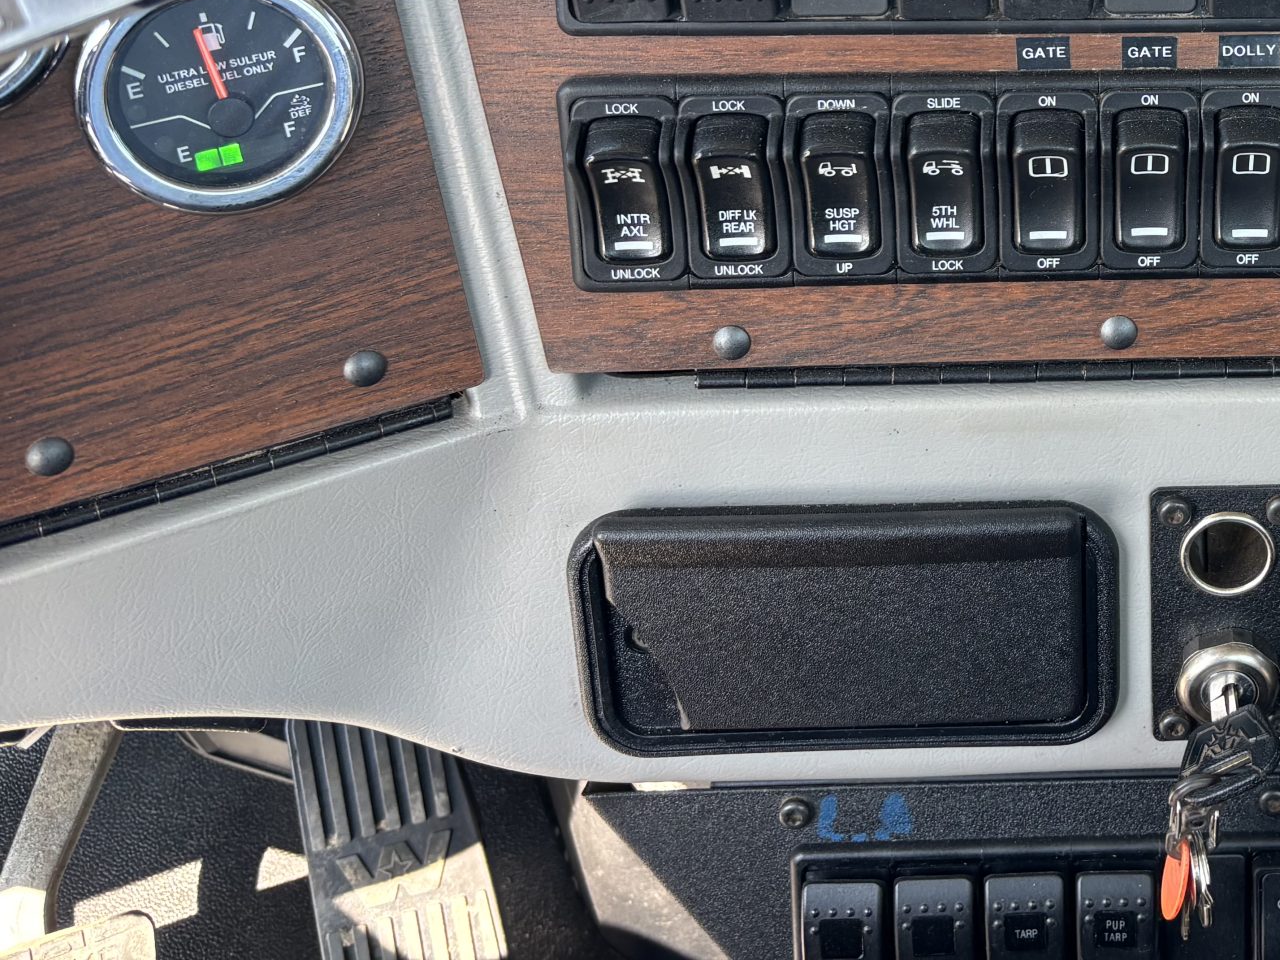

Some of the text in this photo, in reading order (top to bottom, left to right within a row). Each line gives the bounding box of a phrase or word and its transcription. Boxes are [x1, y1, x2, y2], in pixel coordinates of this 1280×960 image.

[292, 46, 307, 63] F
[1022, 46, 1066, 60] GATE
[1127, 45, 1172, 59] GATE
[1222, 44, 1276, 57] DOLLY
[157, 50, 277, 84] ULTRA LW SULFUR
[165, 62, 275, 94] DIESEL UEL ONLY
[126, 82, 144, 100] E
[1038, 96, 1057, 107] ON
[1141, 95, 1159, 106] ON
[1242, 92, 1260, 103] ON
[712, 100, 746, 111] LOCK
[817, 99, 856, 111] DOWN
[927, 98, 961, 109] SLIDE
[290, 106, 312, 119] DEF
[605, 104, 639, 115] LOCK
[283, 121, 296, 137] F
[177, 146, 192, 163] E
[718, 210, 757, 221] DIFF LK
[825, 208, 860, 219] SUSP
[932, 206, 957, 217] 5TH
[616, 213, 651, 225] INTR
[930, 218, 960, 229] WHL
[722, 222, 755, 233] REAR
[829, 220, 857, 231] HGT
[621, 226, 648, 237] AXL
[1037, 258, 1061, 269] OFF
[1137, 256, 1161, 267] OFF
[1236, 254, 1260, 265] OFF
[714, 264, 764, 276] UNLOCK
[836, 262, 853, 273] UP
[932, 260, 963, 271] LOCK
[611, 268, 661, 280] UNLOCK
[1105, 919, 1126, 930] PUP
[1015, 929, 1038, 940] TARP
[1104, 932, 1128, 942] TARP
